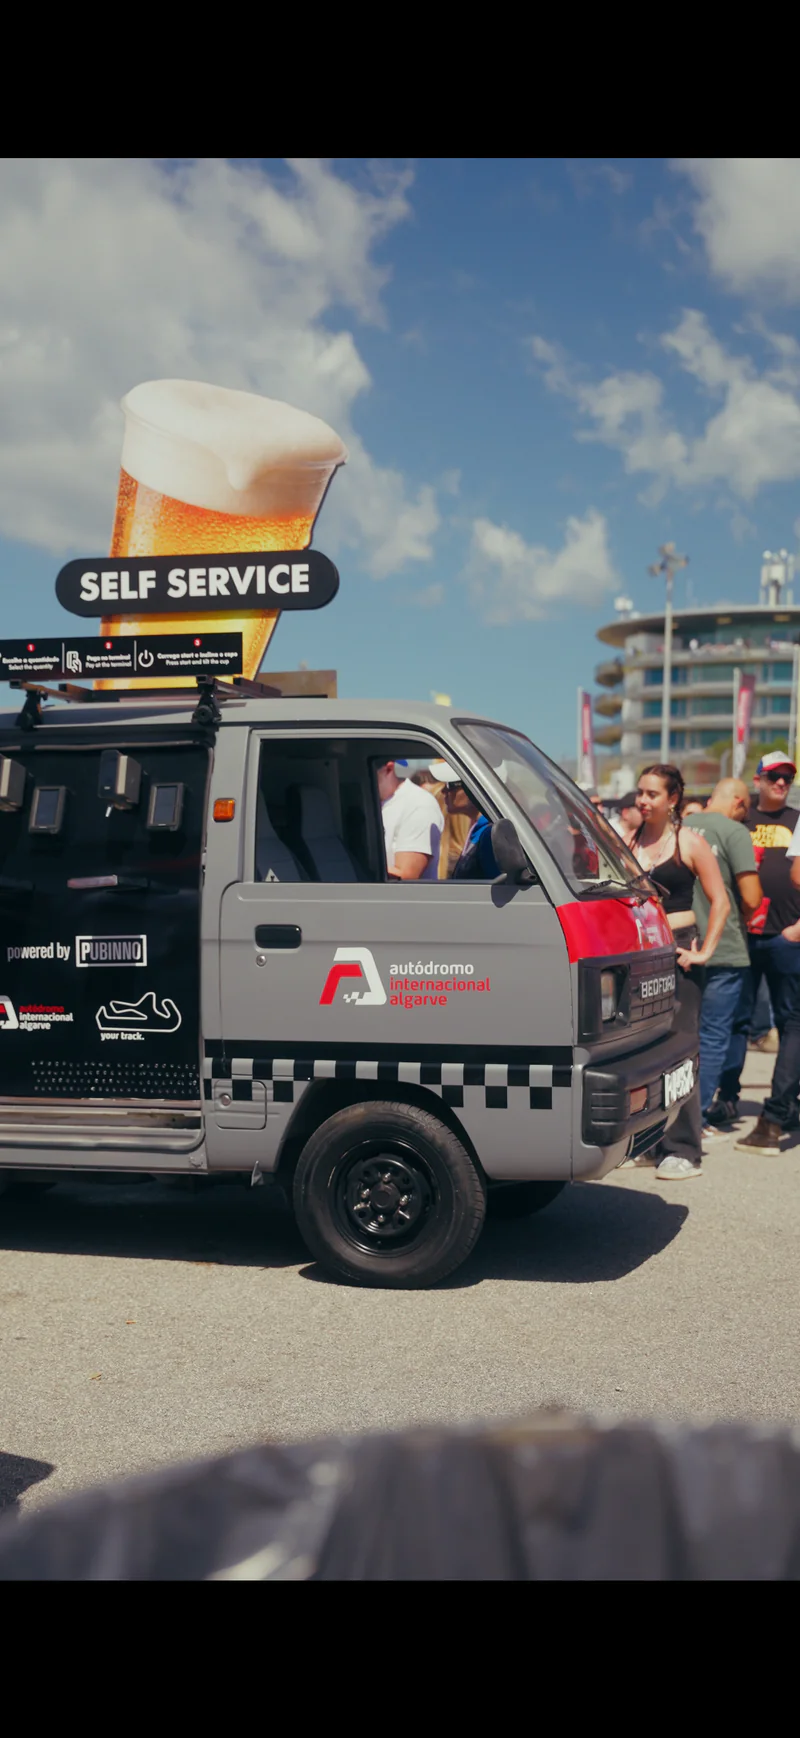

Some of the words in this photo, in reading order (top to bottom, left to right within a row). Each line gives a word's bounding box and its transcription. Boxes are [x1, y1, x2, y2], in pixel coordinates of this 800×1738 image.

[79, 570, 156, 601] SELF
[167, 563, 310, 598] SERVICE
[7, 942, 54, 962] powered
[56, 942, 70, 961] by
[81, 942, 142, 960] PUBINNO
[390, 960, 474, 975] autódromo
[390, 977, 491, 991] internacional
[642, 974, 676, 998] BEDFORD
[390, 992, 448, 1009] algarve
[19, 1012, 73, 1022] internacional
[19, 1021, 51, 1031] algarve
[100, 1032, 119, 1041] your
[121, 1032, 145, 1040] track.
